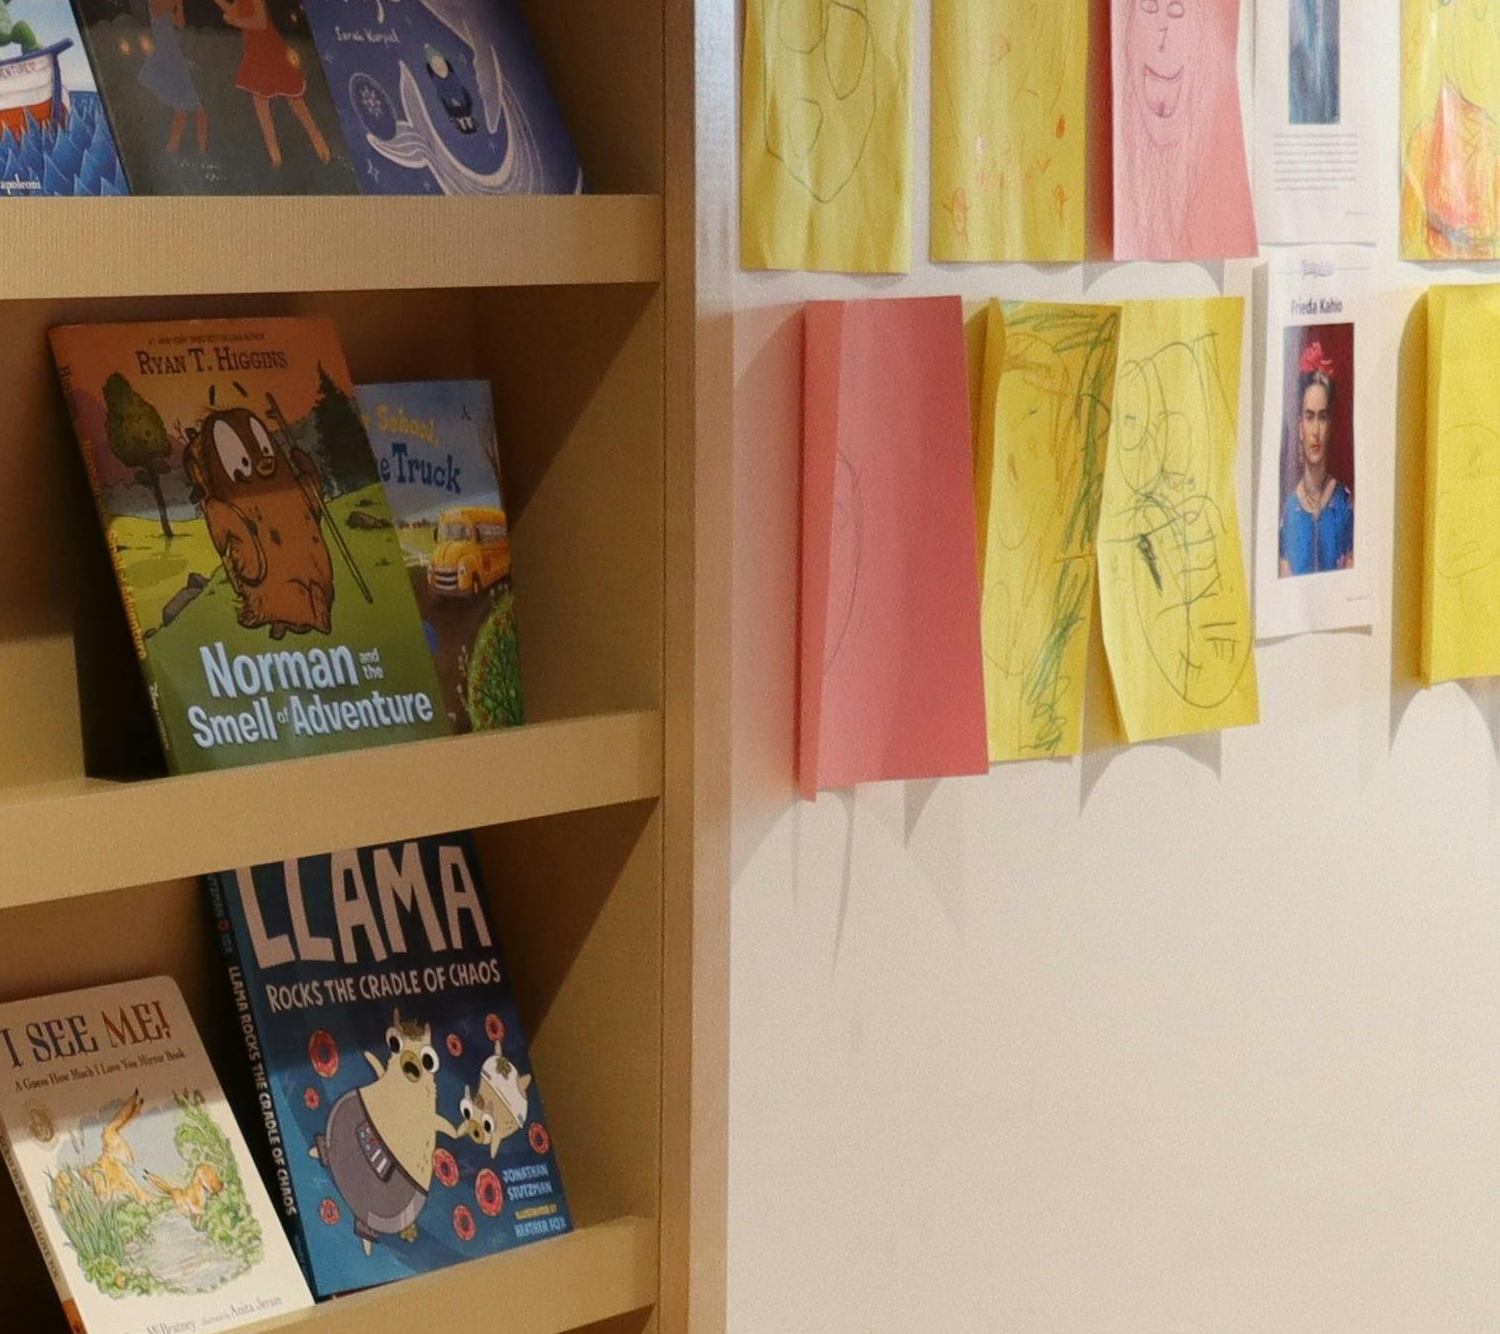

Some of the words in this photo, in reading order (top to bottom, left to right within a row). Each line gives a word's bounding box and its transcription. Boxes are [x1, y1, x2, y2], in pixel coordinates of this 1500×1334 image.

[187, 347, 213, 373] T.
[391, 442, 462, 494] Truck
[199, 642, 360, 702] Norman
[357, 648, 381, 665] and
[360, 664, 385, 681] the
[186, 705, 280, 751] Smell
[276, 705, 290, 725] of
[291, 690, 435, 740] Adventure
[235, 840, 493, 970] LLAMA
[264, 977, 325, 1014] ROCKS
[323, 972, 358, 1002] THE
[358, 965, 421, 998] CRADLE
[422, 960, 448, 990] OF
[448, 957, 502, 987] CHAOS
[0, 1027, 26, 1070] I
[25, 1015, 100, 1066] SEE
[100, 999, 174, 1050] ME!
[501, 1162, 549, 1185] JONATHAN
